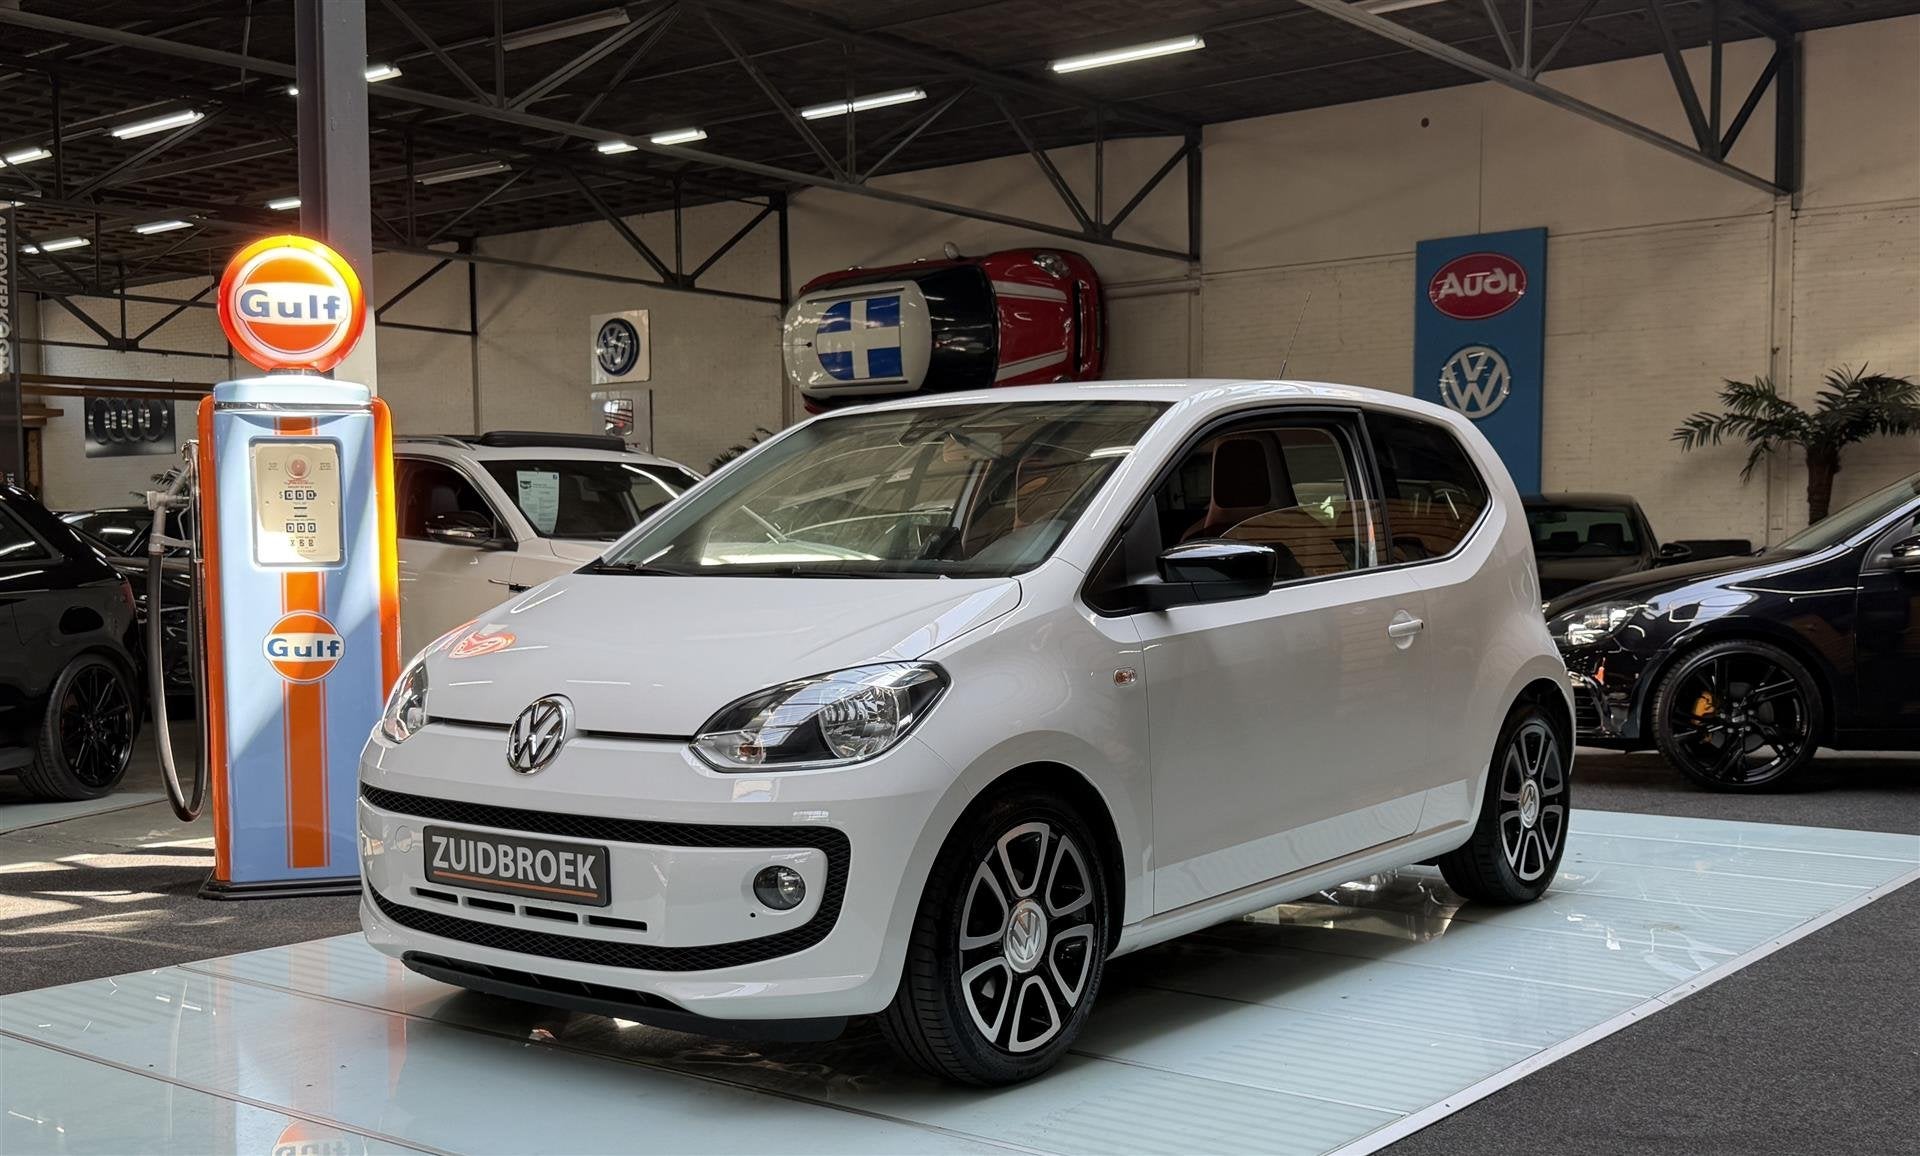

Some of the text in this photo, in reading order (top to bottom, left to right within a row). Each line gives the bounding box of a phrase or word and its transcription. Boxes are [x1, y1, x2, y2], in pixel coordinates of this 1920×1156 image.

[240, 289, 341, 320] Gulf
[267, 638, 341, 658] Gulf
[431, 835, 598, 889] ZUIDBROEK
